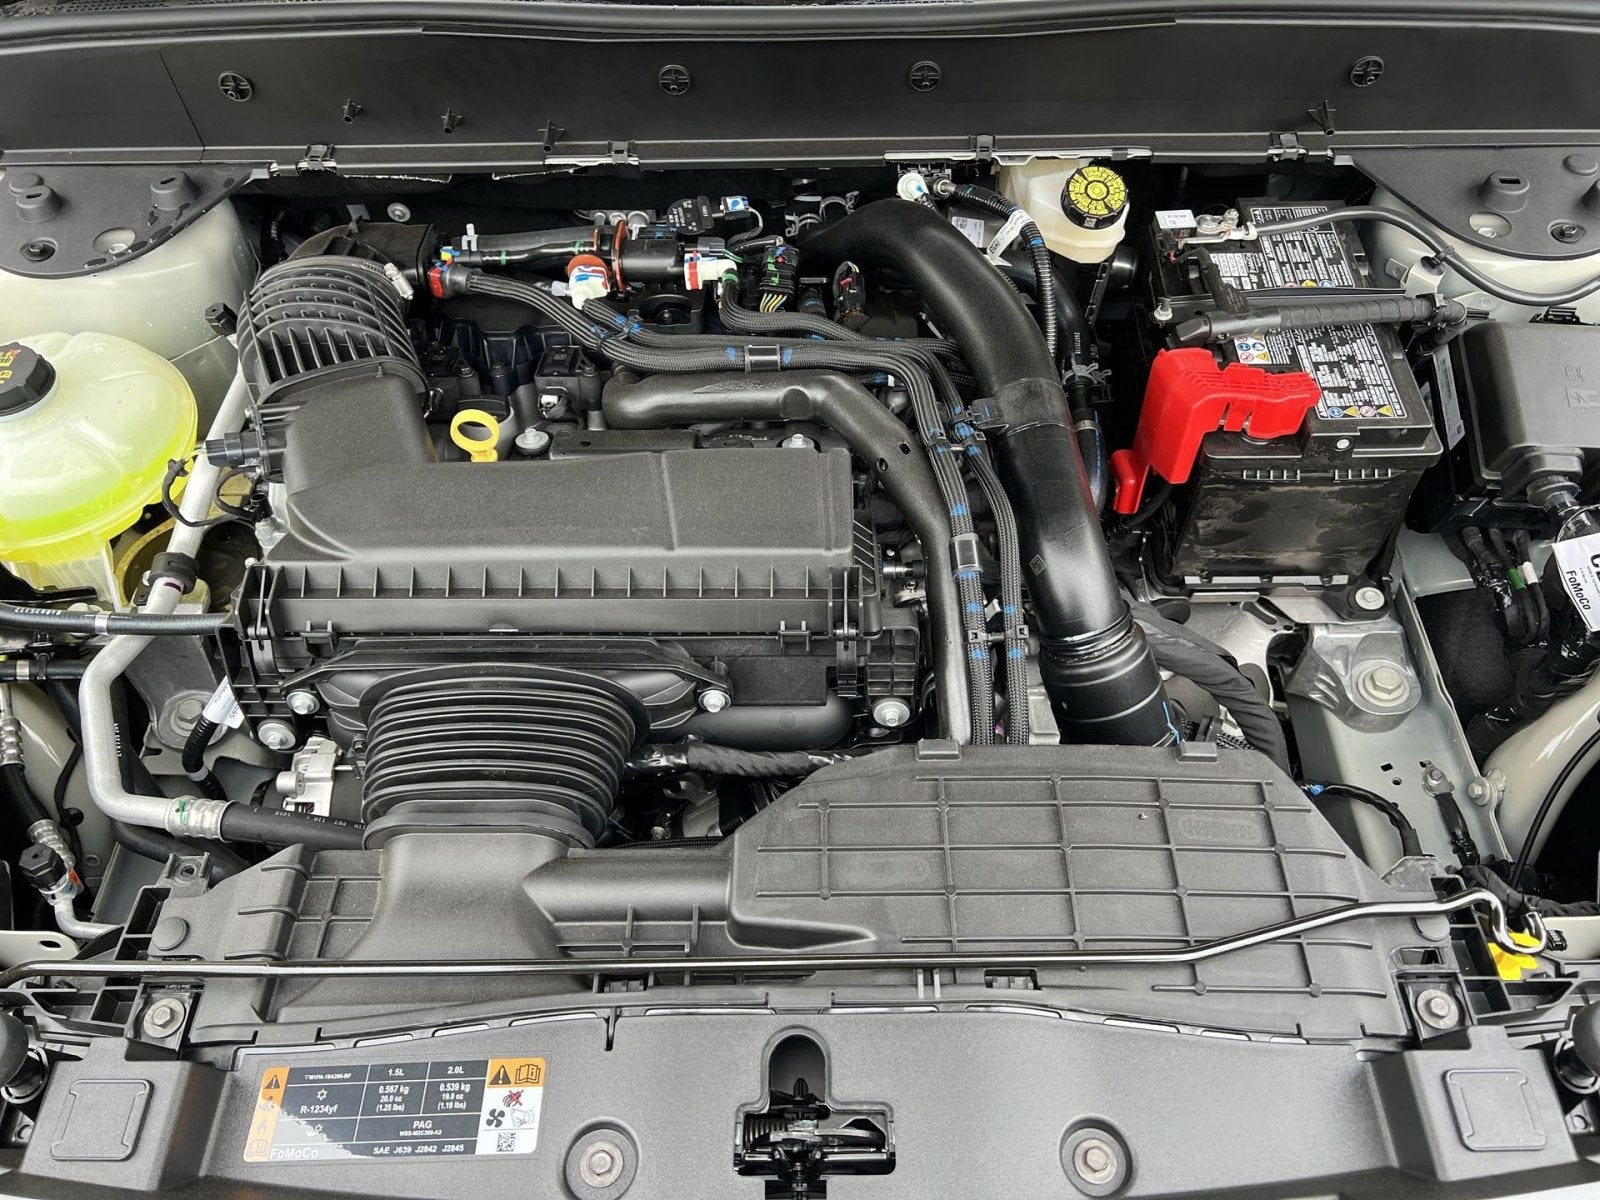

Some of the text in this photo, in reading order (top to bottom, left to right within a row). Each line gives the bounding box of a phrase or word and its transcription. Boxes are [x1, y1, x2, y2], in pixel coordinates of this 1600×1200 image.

[1565, 569, 1591, 610] FoMoCo
[388, 1068, 405, 1077] 1.5L
[447, 1066, 465, 1075] 2.0L
[378, 1085, 410, 1095] 0.567 kg
[440, 1082, 471, 1093] 0.539 kg
[299, 1104, 339, 1115] R-1234yf
[392, 1103, 405, 1112] lbs)
[453, 1101, 467, 1110] lbs)
[412, 1120, 432, 1129] PAG
[269, 1146, 319, 1160] FoMoCo
[373, 1146, 391, 1155] SAE
[393, 1145, 412, 1154] J639
[414, 1144, 438, 1153] J2842
